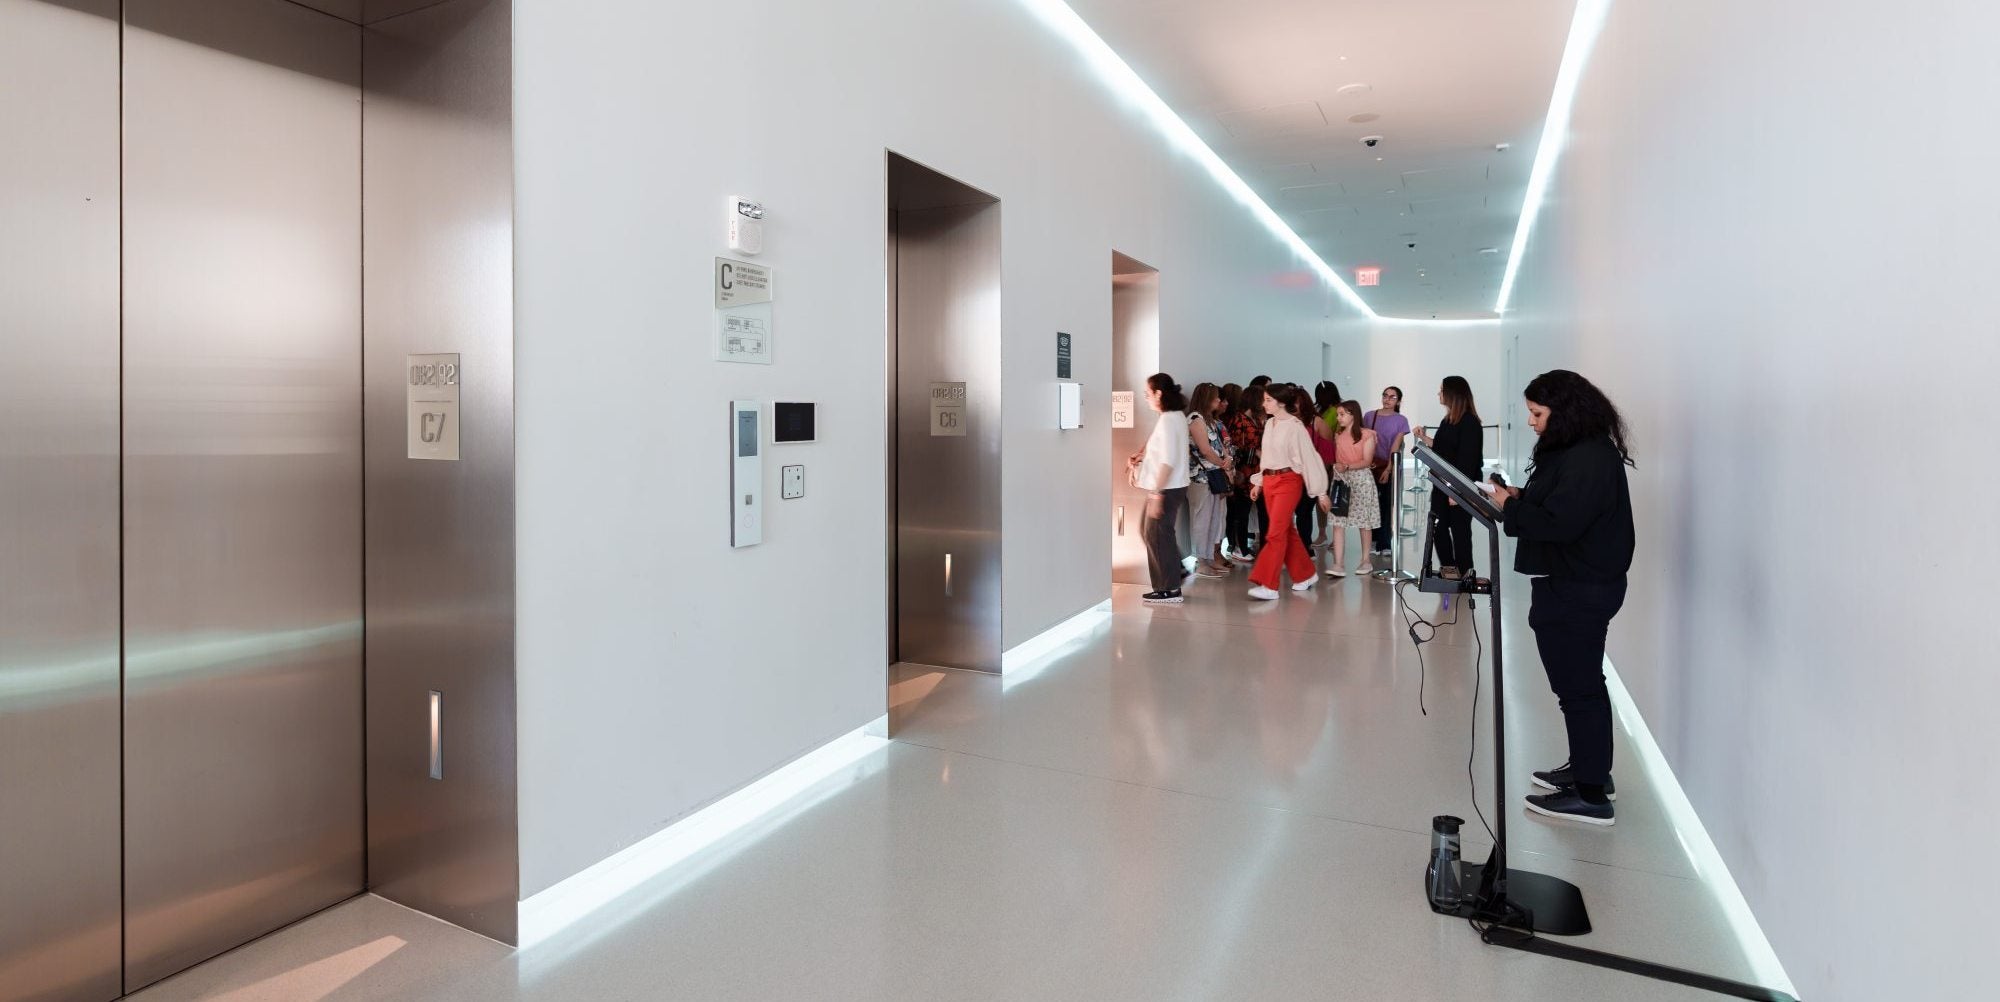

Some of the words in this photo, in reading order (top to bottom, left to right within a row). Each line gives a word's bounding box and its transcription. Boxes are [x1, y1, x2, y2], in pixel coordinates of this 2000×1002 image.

[721, 263, 732, 290] C
[1358, 270, 1378, 286] EXIT
[940, 411, 957, 428] C6
[1114, 411, 1127, 423] C5
[421, 412, 446, 443] C7
